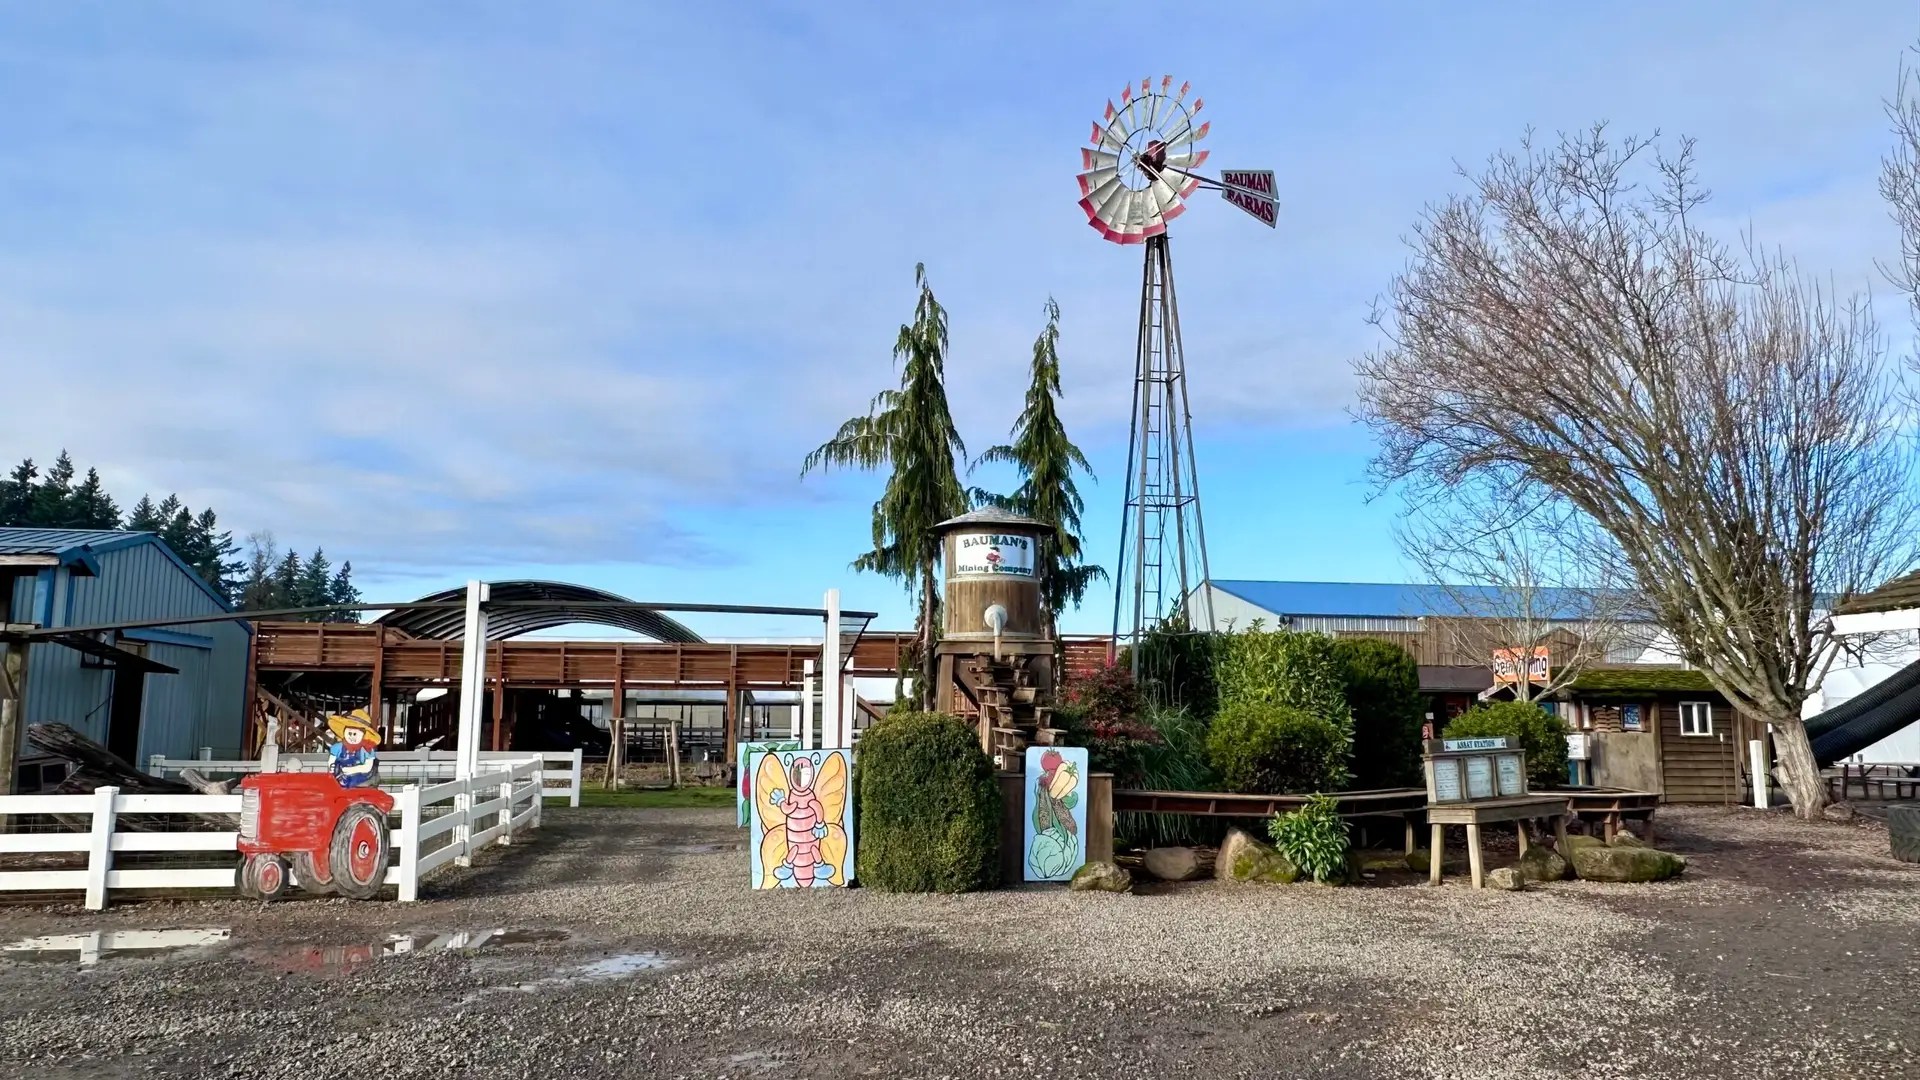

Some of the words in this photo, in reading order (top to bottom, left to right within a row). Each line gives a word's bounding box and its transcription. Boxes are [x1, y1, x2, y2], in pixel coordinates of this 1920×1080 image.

[1224, 172, 1272, 194] BAUMAN
[1226, 188, 1274, 222] FARMS
[963, 535, 1028, 550] BAUMAN'S
[958, 564, 989, 573] Mining
[992, 564, 1032, 575] Company
